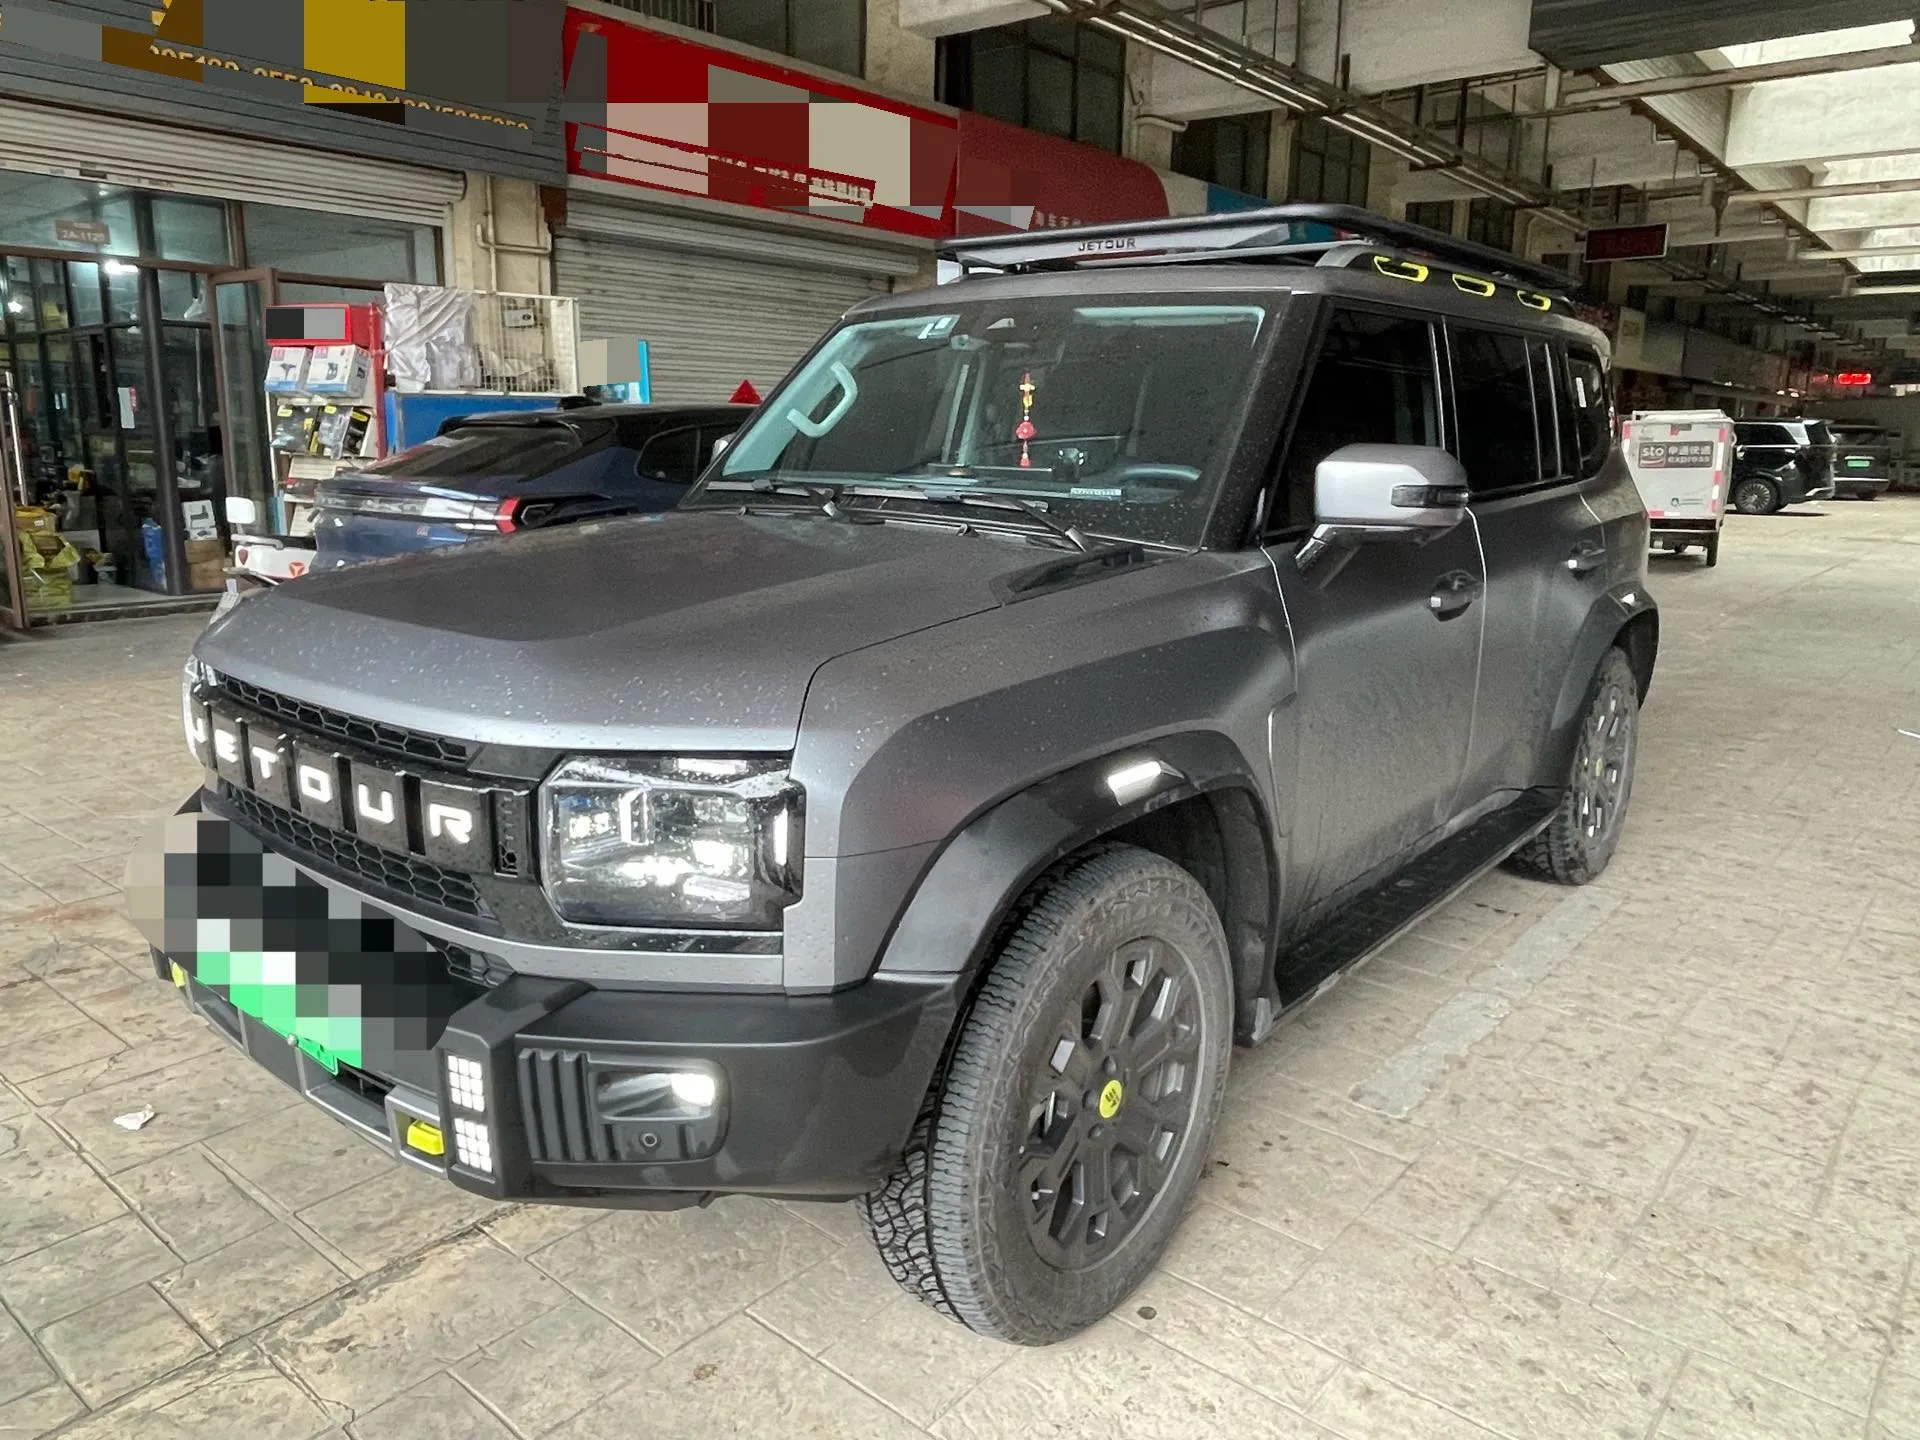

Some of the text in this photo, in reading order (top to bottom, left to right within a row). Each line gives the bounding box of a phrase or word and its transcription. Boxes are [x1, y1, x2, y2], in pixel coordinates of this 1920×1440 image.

[1078, 238, 1136, 251] JETOUR
[1642, 446, 1665, 457] sto
[1667, 456, 1711, 464] express
[185, 717, 473, 844] JETOUR
